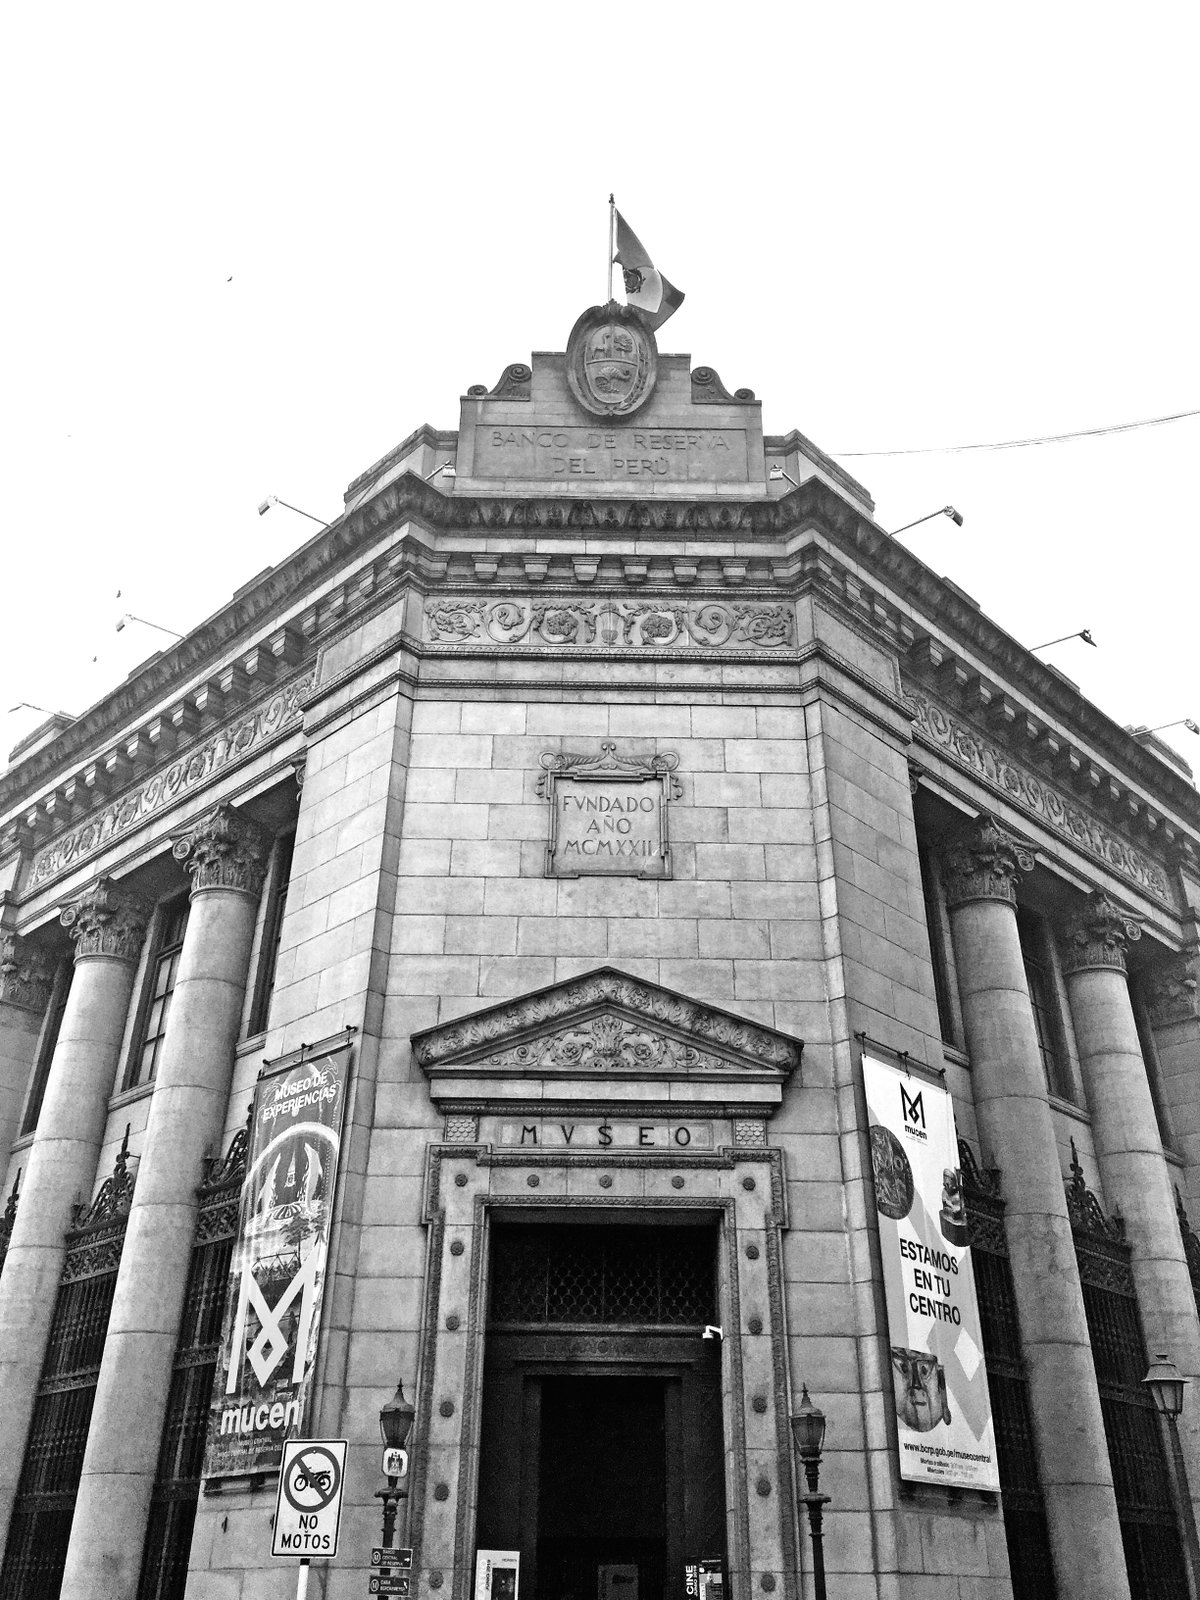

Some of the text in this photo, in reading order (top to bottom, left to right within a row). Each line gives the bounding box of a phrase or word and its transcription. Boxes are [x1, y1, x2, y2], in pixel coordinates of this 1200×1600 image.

[491, 431, 729, 450] BANCO DE RESERVA
[553, 457, 595, 474] DEL
[562, 796, 655, 813] FVNDADO
[586, 815, 632, 834] AÑO
[563, 840, 653, 857] MCMXXII
[274, 1072, 328, 1102] MUSEO DE
[263, 1084, 336, 1121] EXPERIENCIAS
[520, 1126, 691, 1146] MVSEO
[904, 1124, 928, 1140] mucen
[900, 1238, 959, 1276] ESTAMOS
[913, 1269, 951, 1298] EN TU
[909, 1293, 962, 1326] CENTRO
[219, 1400, 300, 1435] mucen
[299, 1514, 319, 1530] NO
[280, 1533, 331, 1550] MOTOS
[685, 1565, 693, 1595] CINE
